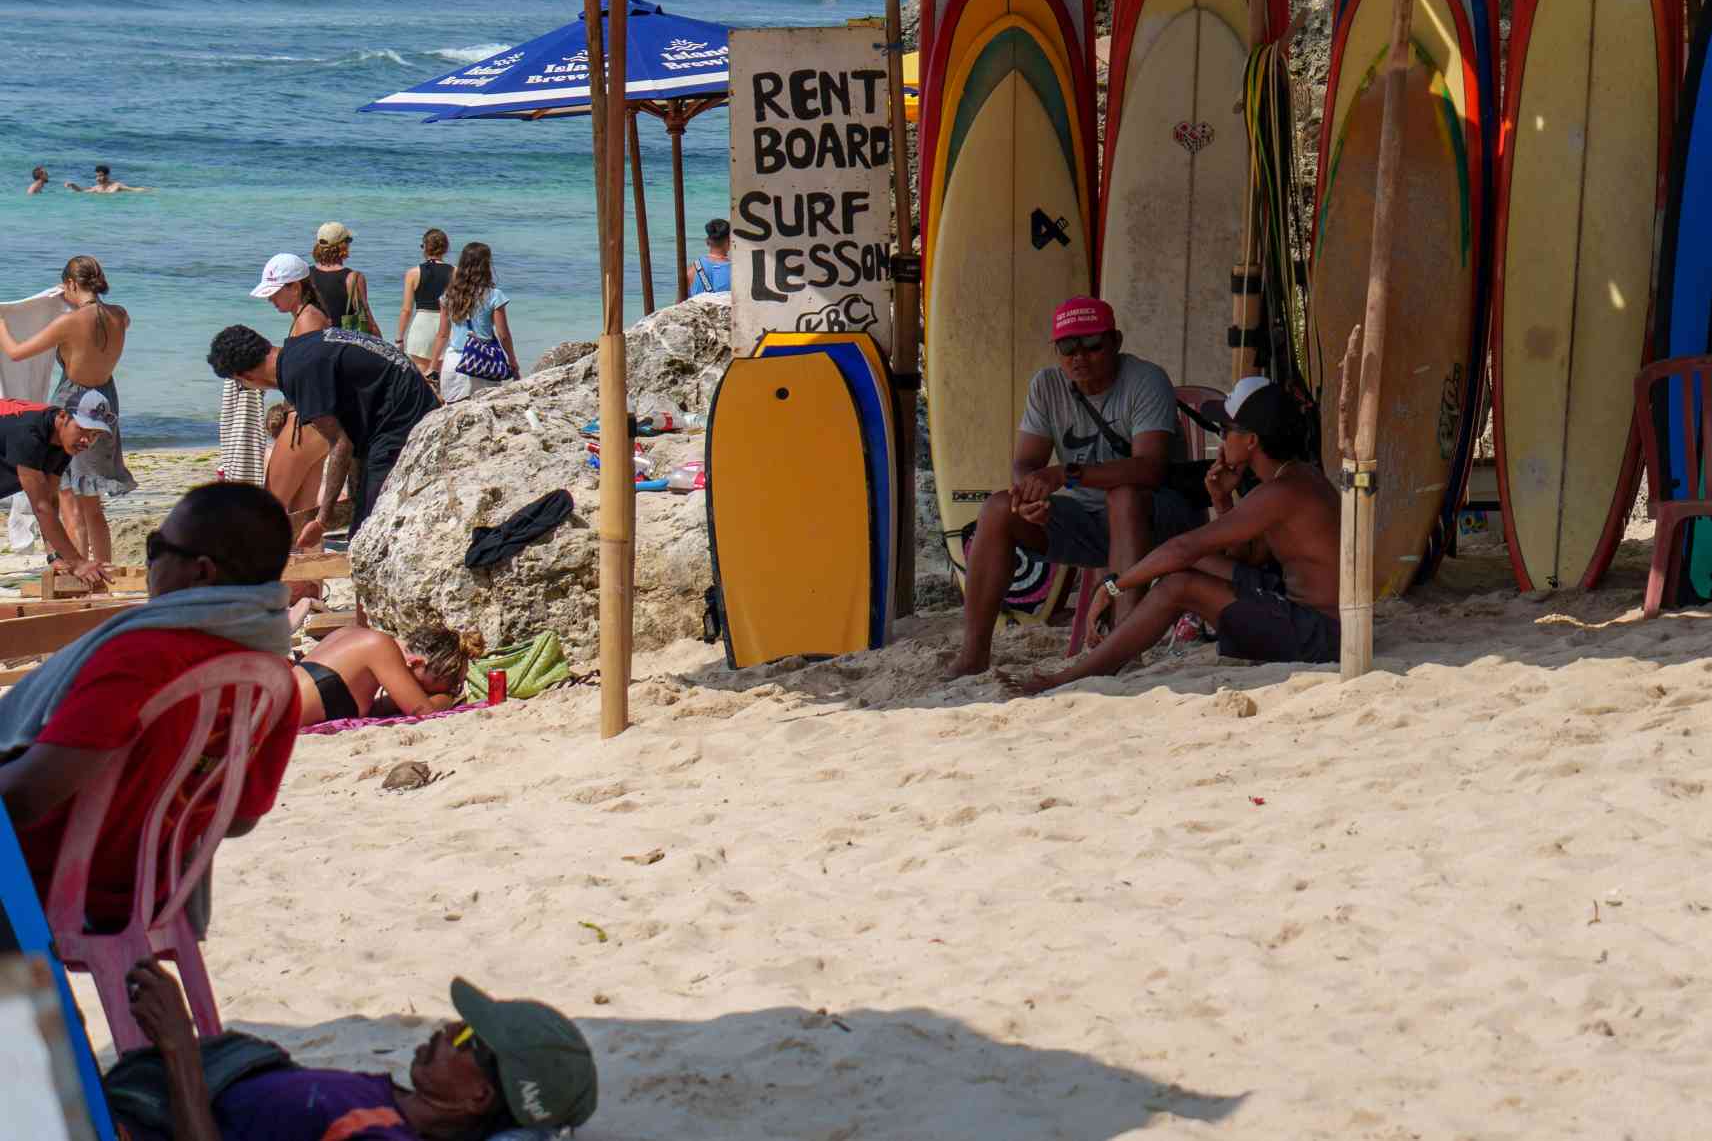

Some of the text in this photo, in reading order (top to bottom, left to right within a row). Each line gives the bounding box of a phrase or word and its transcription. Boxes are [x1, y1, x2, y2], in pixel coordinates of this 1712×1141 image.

[752, 69, 887, 122] RENT
[753, 123, 890, 174] BOARD
[733, 190, 870, 242] SURF
[751, 240, 890, 303] LESSON
